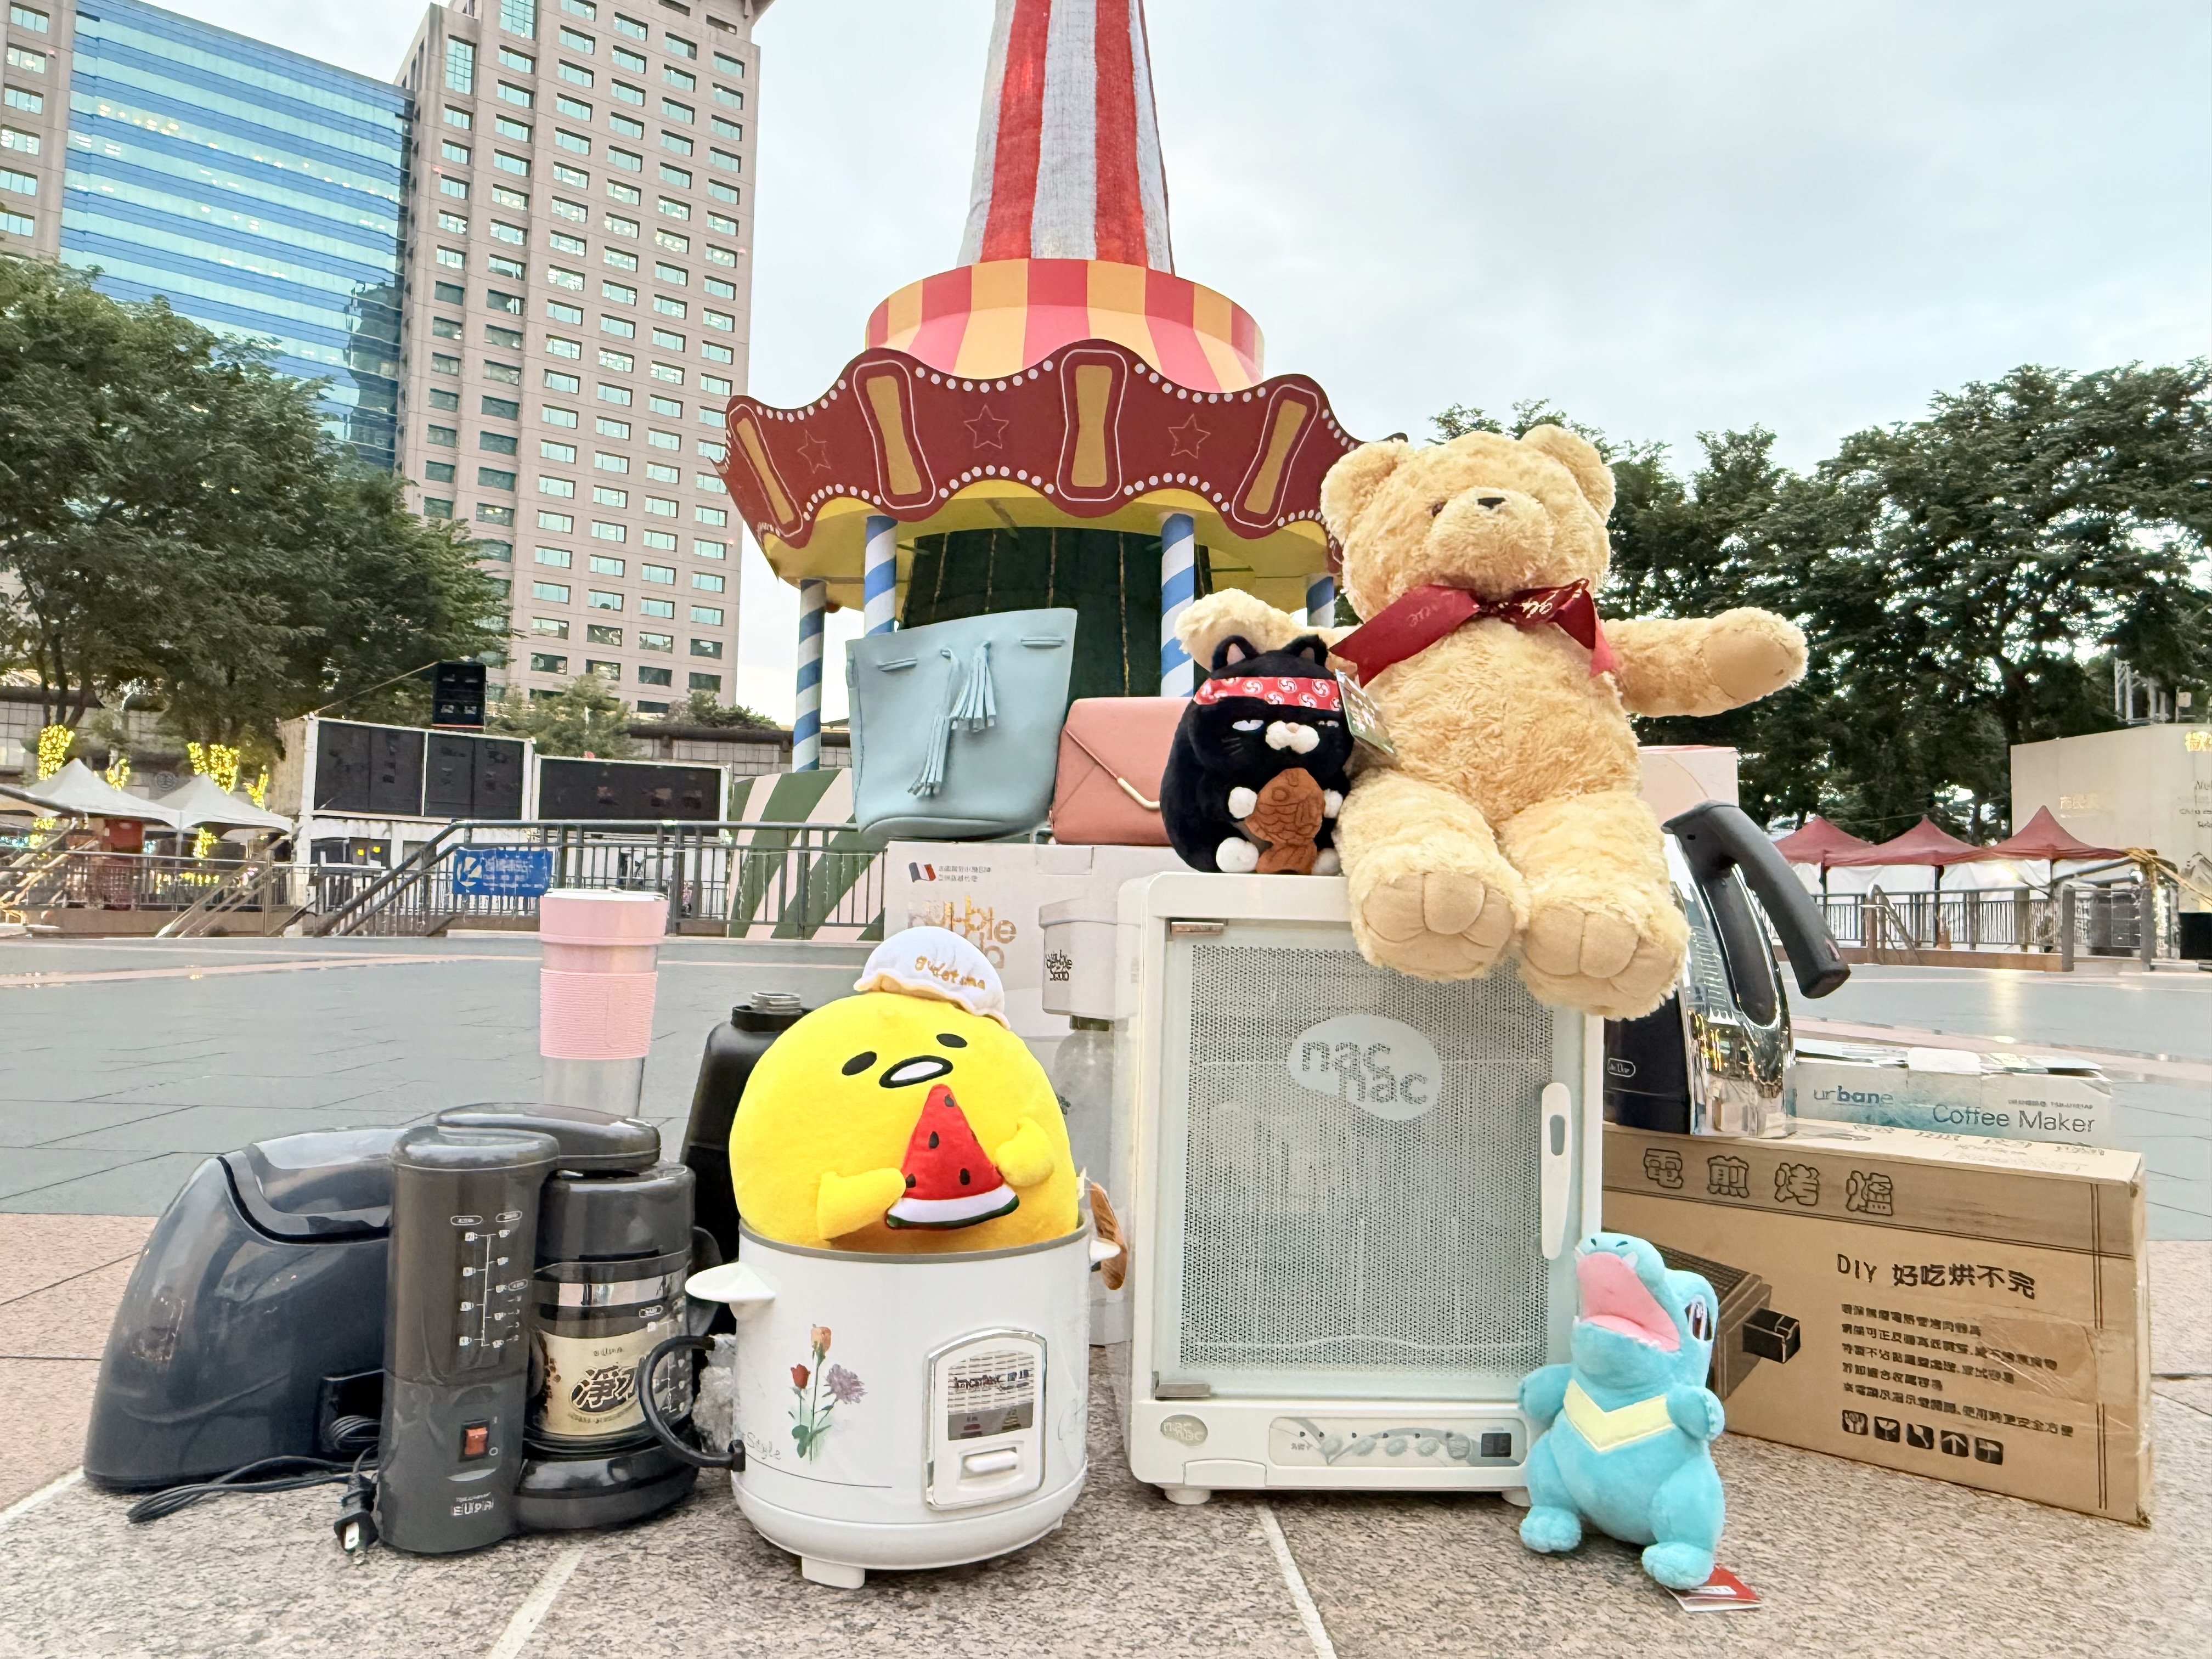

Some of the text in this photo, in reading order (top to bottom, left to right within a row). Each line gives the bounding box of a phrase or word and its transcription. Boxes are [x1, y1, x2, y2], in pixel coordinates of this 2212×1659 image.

[1813, 1085, 1894, 1105] urbane
[1932, 1103, 2096, 1133] Coffee Maker
[1837, 1253, 2036, 1300] DIY 好吃烘不完
[453, 1500, 494, 1516] EUPA
